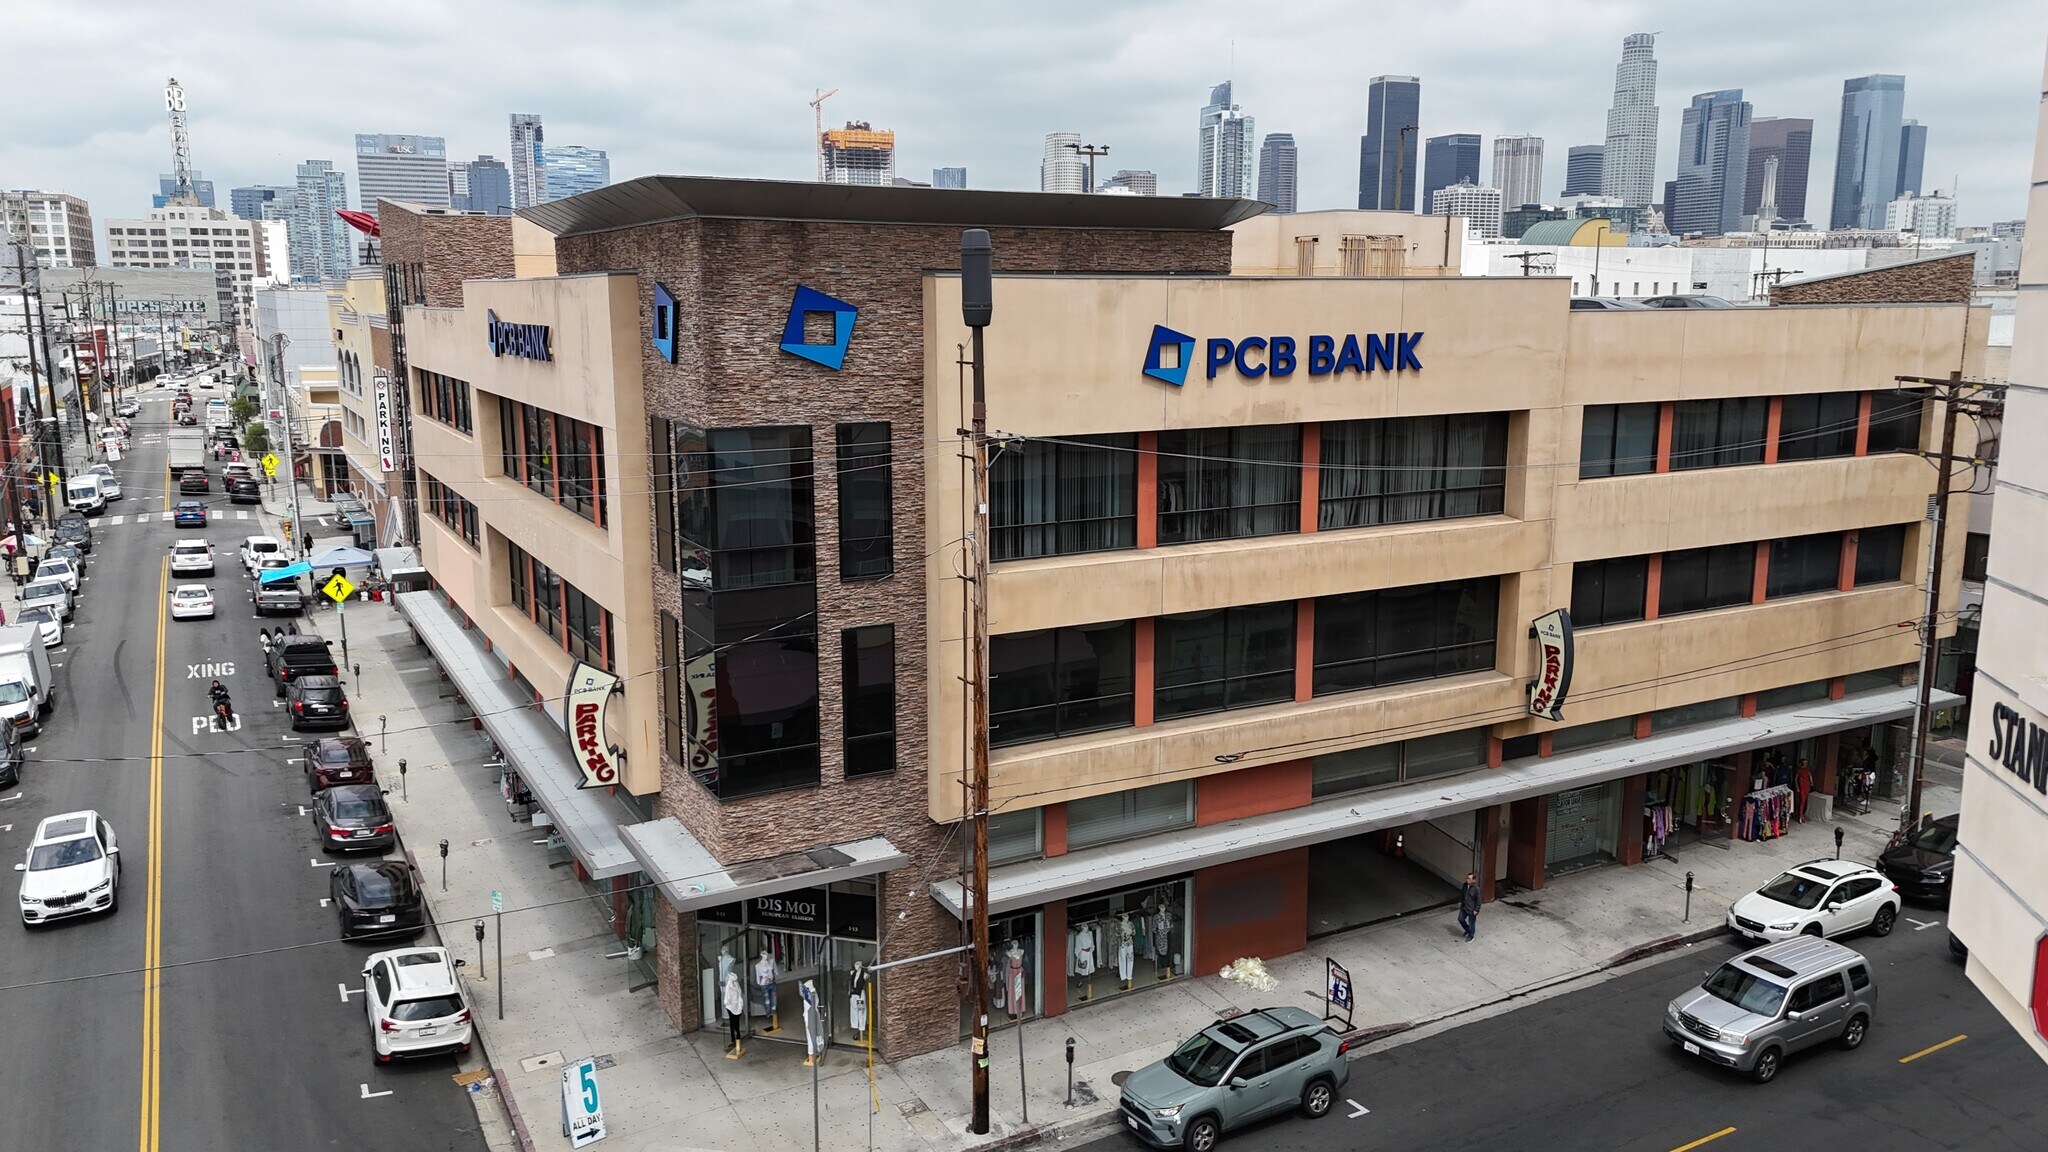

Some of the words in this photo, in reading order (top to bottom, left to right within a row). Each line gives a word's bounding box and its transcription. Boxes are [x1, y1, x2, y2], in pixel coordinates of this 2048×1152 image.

[397, 145, 414, 154] USC
[495, 321, 517, 357] PCB
[518, 323, 551, 362] BANK
[1207, 336, 1297, 379] PCB
[1309, 332, 1424, 375] BANK
[378, 392, 391, 455] PARKING
[187, 661, 235, 679] XING
[1533, 644, 1561, 713] PARKING
[576, 703, 615, 783] PARKING
[757, 897, 782, 912] DIS
[785, 900, 817, 916] MOI
[761, 911, 790, 919] EUROPEAN
[580, 1063, 598, 1113] 5
[573, 1118, 586, 1131] ALL
[587, 1113, 602, 1126] DAY
